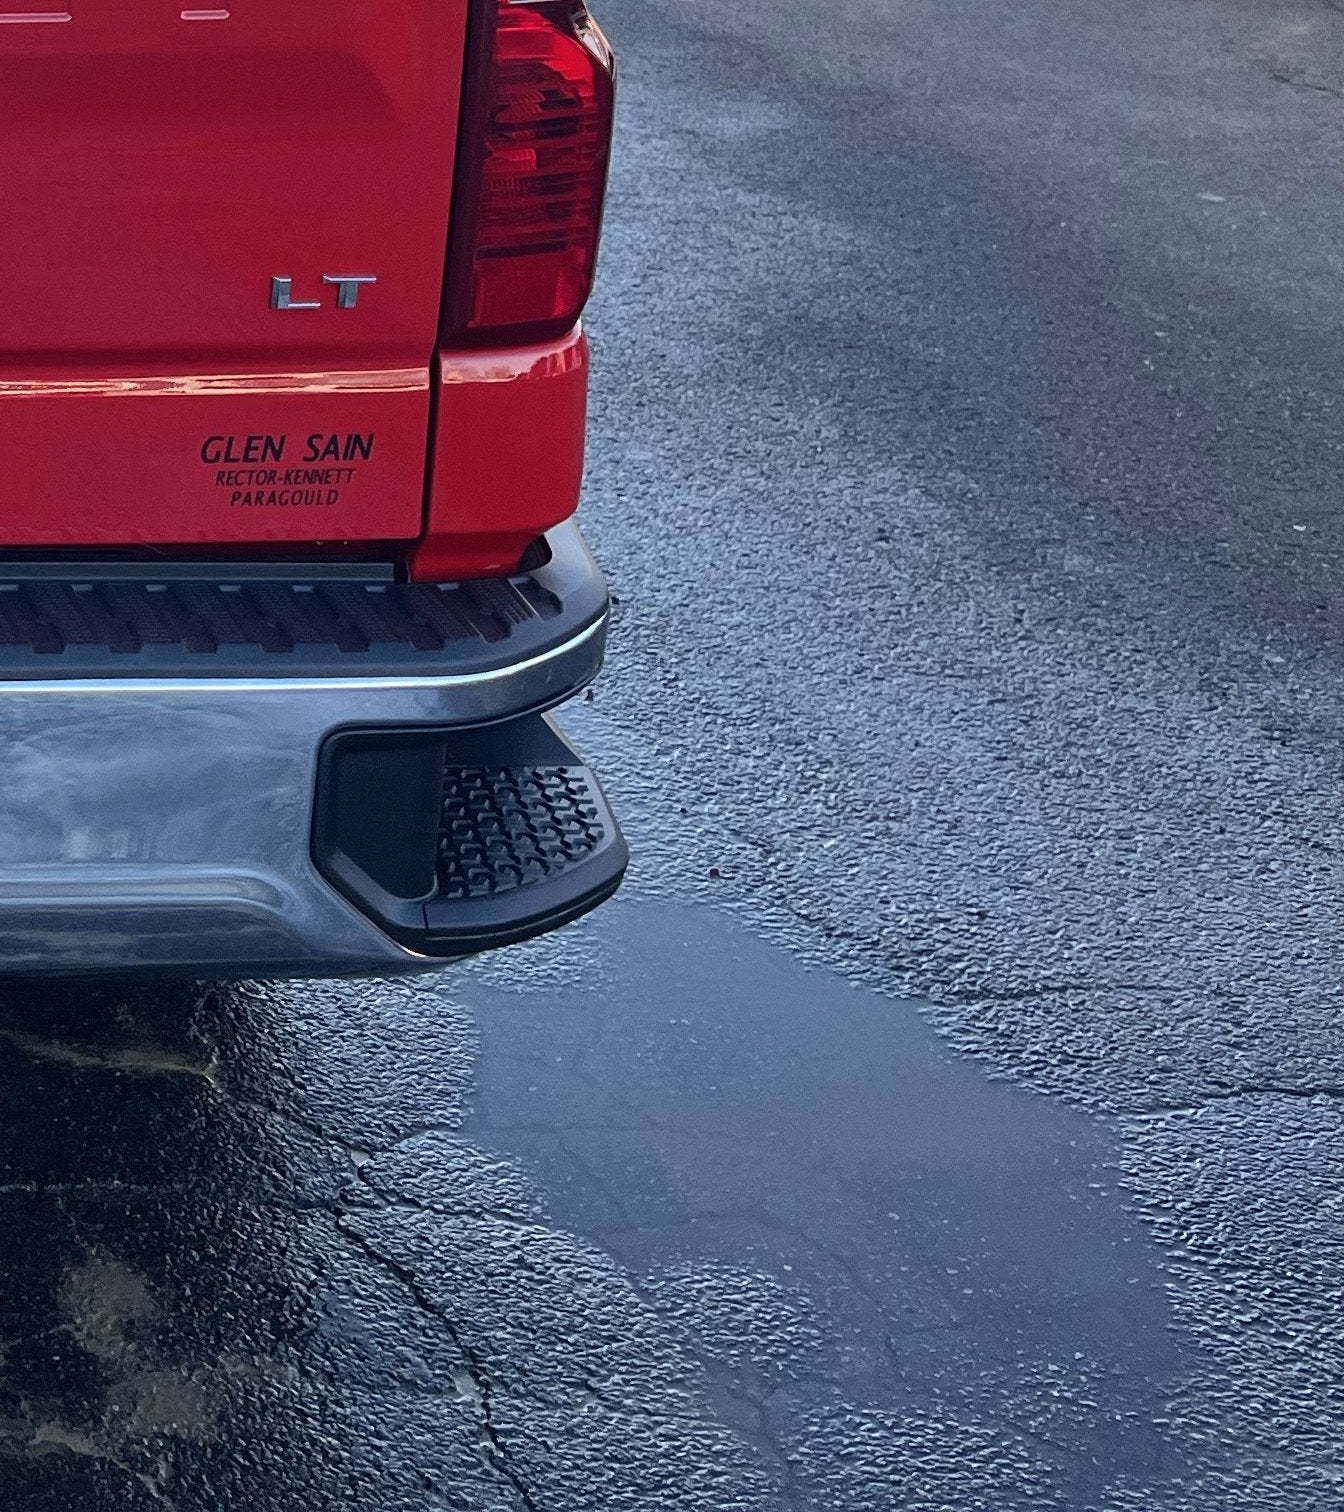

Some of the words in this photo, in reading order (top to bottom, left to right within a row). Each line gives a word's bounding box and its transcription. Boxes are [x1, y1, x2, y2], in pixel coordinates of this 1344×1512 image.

[270, 274, 377, 309] LT
[200, 435, 285, 464] GLEN
[302, 433, 375, 462] SAIN
[215, 468, 357, 487] RECTOR-KENNETT
[229, 489, 339, 506] PARAGOULD
